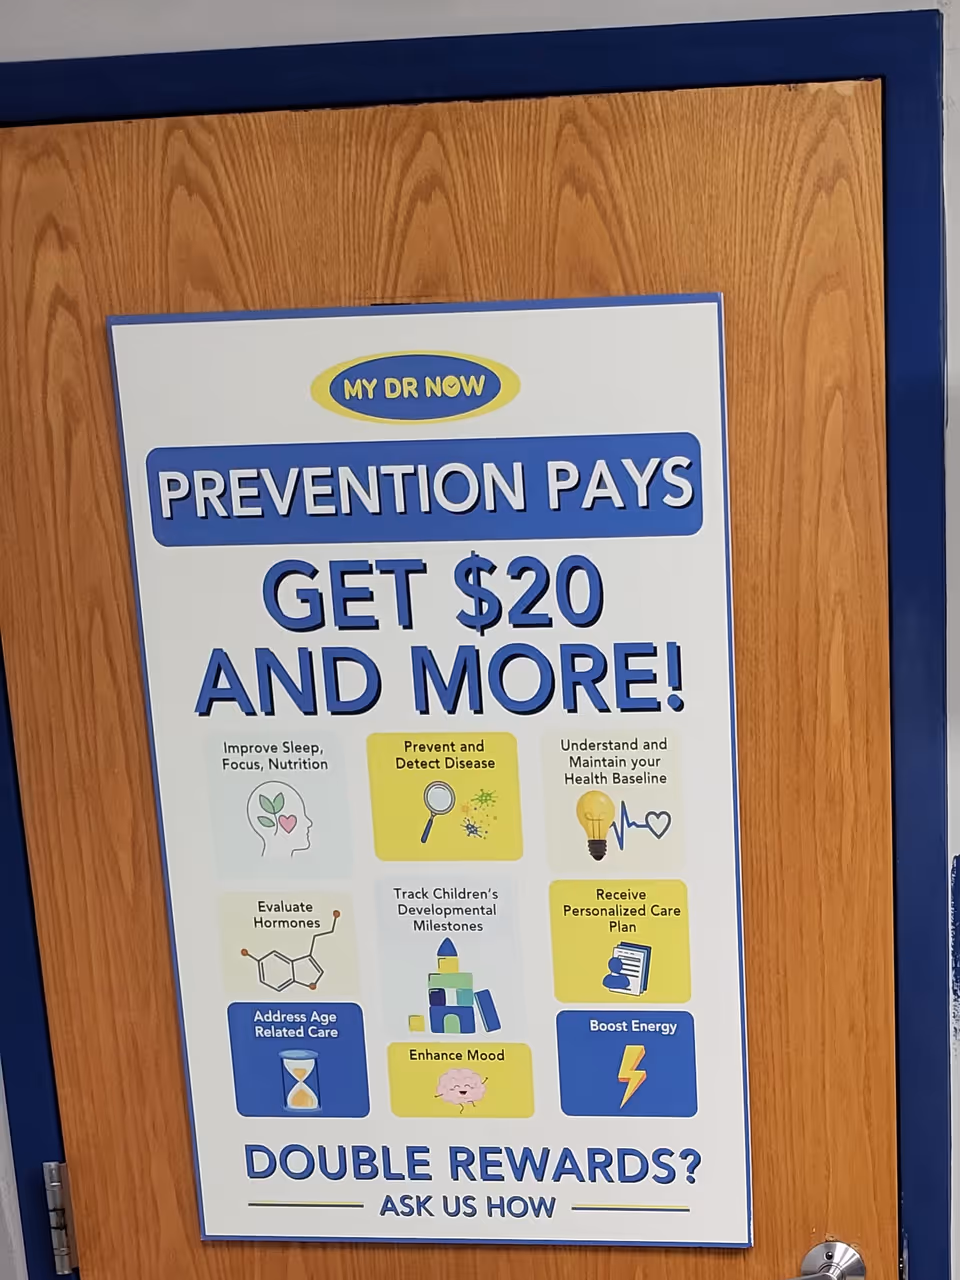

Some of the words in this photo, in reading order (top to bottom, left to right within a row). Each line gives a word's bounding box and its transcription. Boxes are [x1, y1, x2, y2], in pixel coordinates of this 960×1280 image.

[344, 378, 377, 400] MY
[385, 377, 417, 399] DR
[425, 375, 486, 398] NOW
[158, 461, 527, 519] PREVENTION
[548, 456, 693, 511] PAYS
[262, 558, 427, 632] GET
[454, 550, 604, 636] $20
[195, 646, 382, 717] AND
[411, 641, 685, 716] MORE!
[223, 741, 279, 757] Improve
[283, 741, 324, 757] Sleep,
[404, 740, 456, 753] Prevent
[460, 740, 484, 752] and
[561, 737, 638, 752] Understand
[643, 736, 667, 750] and
[222, 757, 263, 772] Focus,
[269, 757, 328, 771] Nutrition
[395, 756, 440, 770] Detect
[445, 756, 495, 770] Disease
[569, 755, 627, 769] Maintain
[631, 757, 661, 771] your
[564, 772, 608, 786] Health
[613, 772, 667, 785] Baseline
[393, 888, 428, 901] Track
[433, 887, 499, 901] Children's
[596, 889, 646, 902] Receive
[258, 900, 313, 914] Evaluate
[398, 903, 497, 920] Developmental
[563, 904, 647, 918] Personalized
[652, 905, 681, 918] Care
[253, 916, 321, 930] Hormones
[413, 920, 483, 933] Milestones
[609, 920, 637, 934] Plan
[254, 1011, 307, 1024] Address
[308, 1011, 337, 1026] Age
[255, 1026, 304, 1039] Related
[307, 1026, 338, 1039] Care
[590, 1020, 628, 1033] Boost
[631, 1021, 677, 1036] Energy
[409, 1049, 462, 1062] Enhance
[467, 1049, 505, 1061] Mood
[244, 1143, 432, 1181] DOUBLE
[449, 1146, 702, 1186] REWARDS?
[380, 1195, 433, 1218] ASK
[442, 1195, 478, 1218] US
[487, 1195, 556, 1219] HOW
